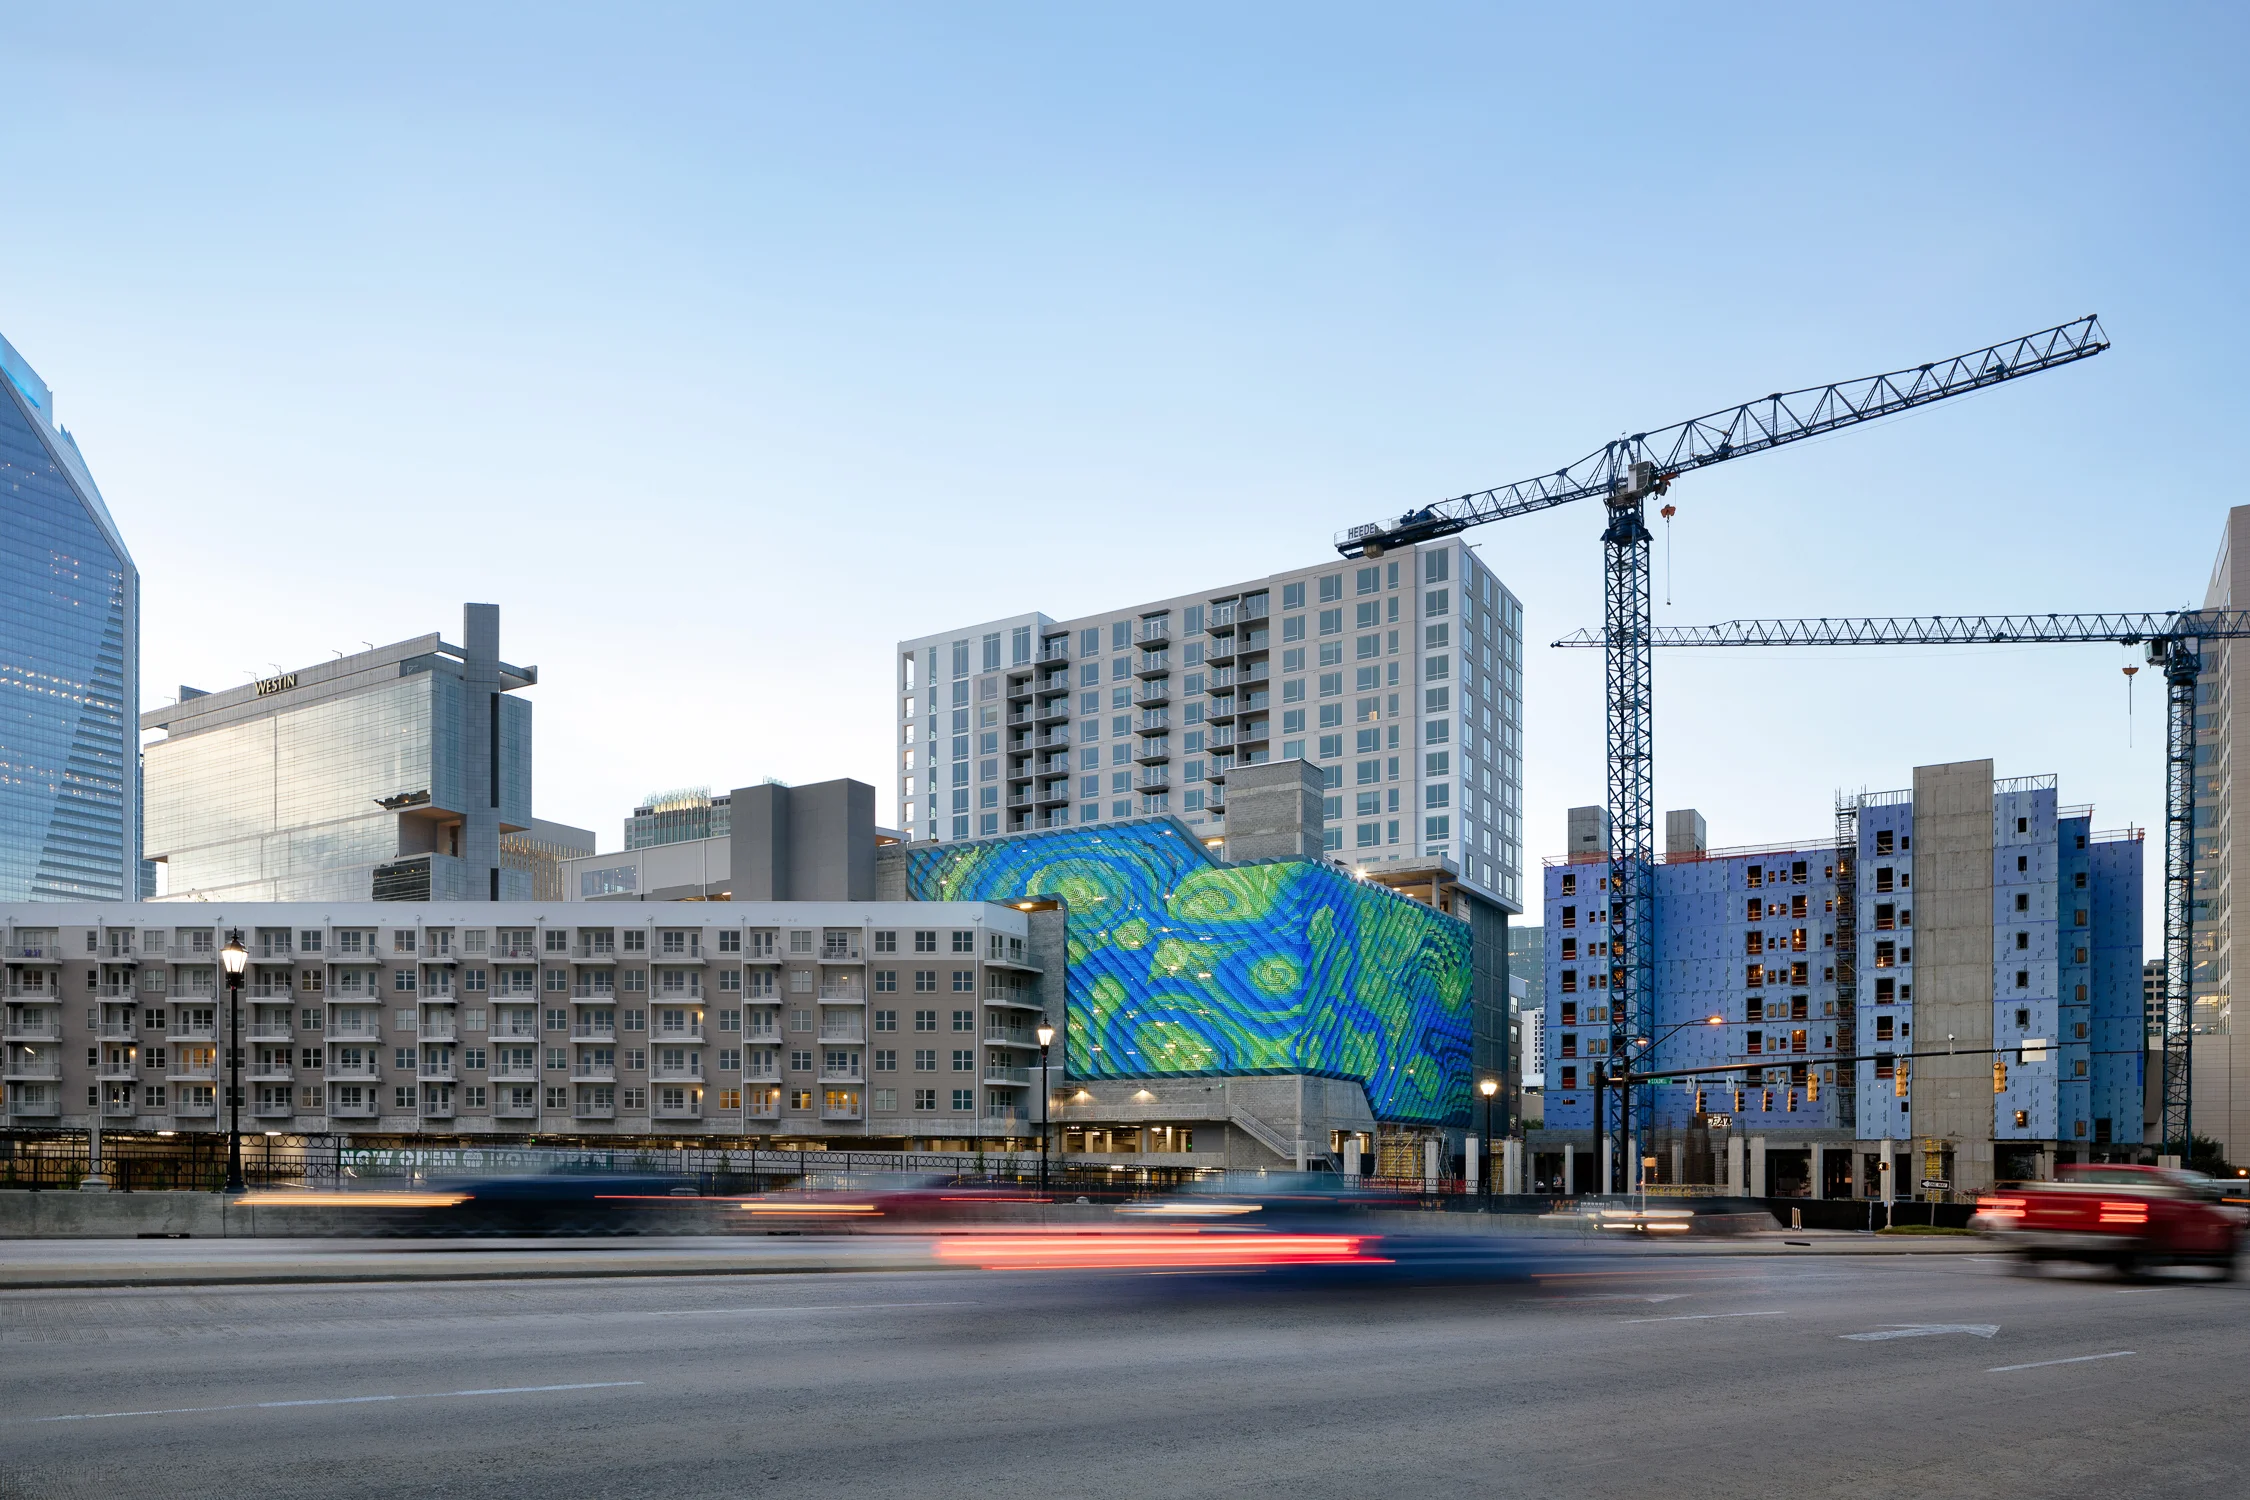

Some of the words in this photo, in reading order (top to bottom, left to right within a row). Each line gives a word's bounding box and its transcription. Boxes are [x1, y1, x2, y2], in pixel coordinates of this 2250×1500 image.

[1348, 522, 1375, 540] HEEDE
[254, 673, 297, 695] WESTIN
[340, 1150, 393, 1166] NOW
[399, 1150, 456, 1166] OPEN
[490, 1152, 543, 1167] NOW
